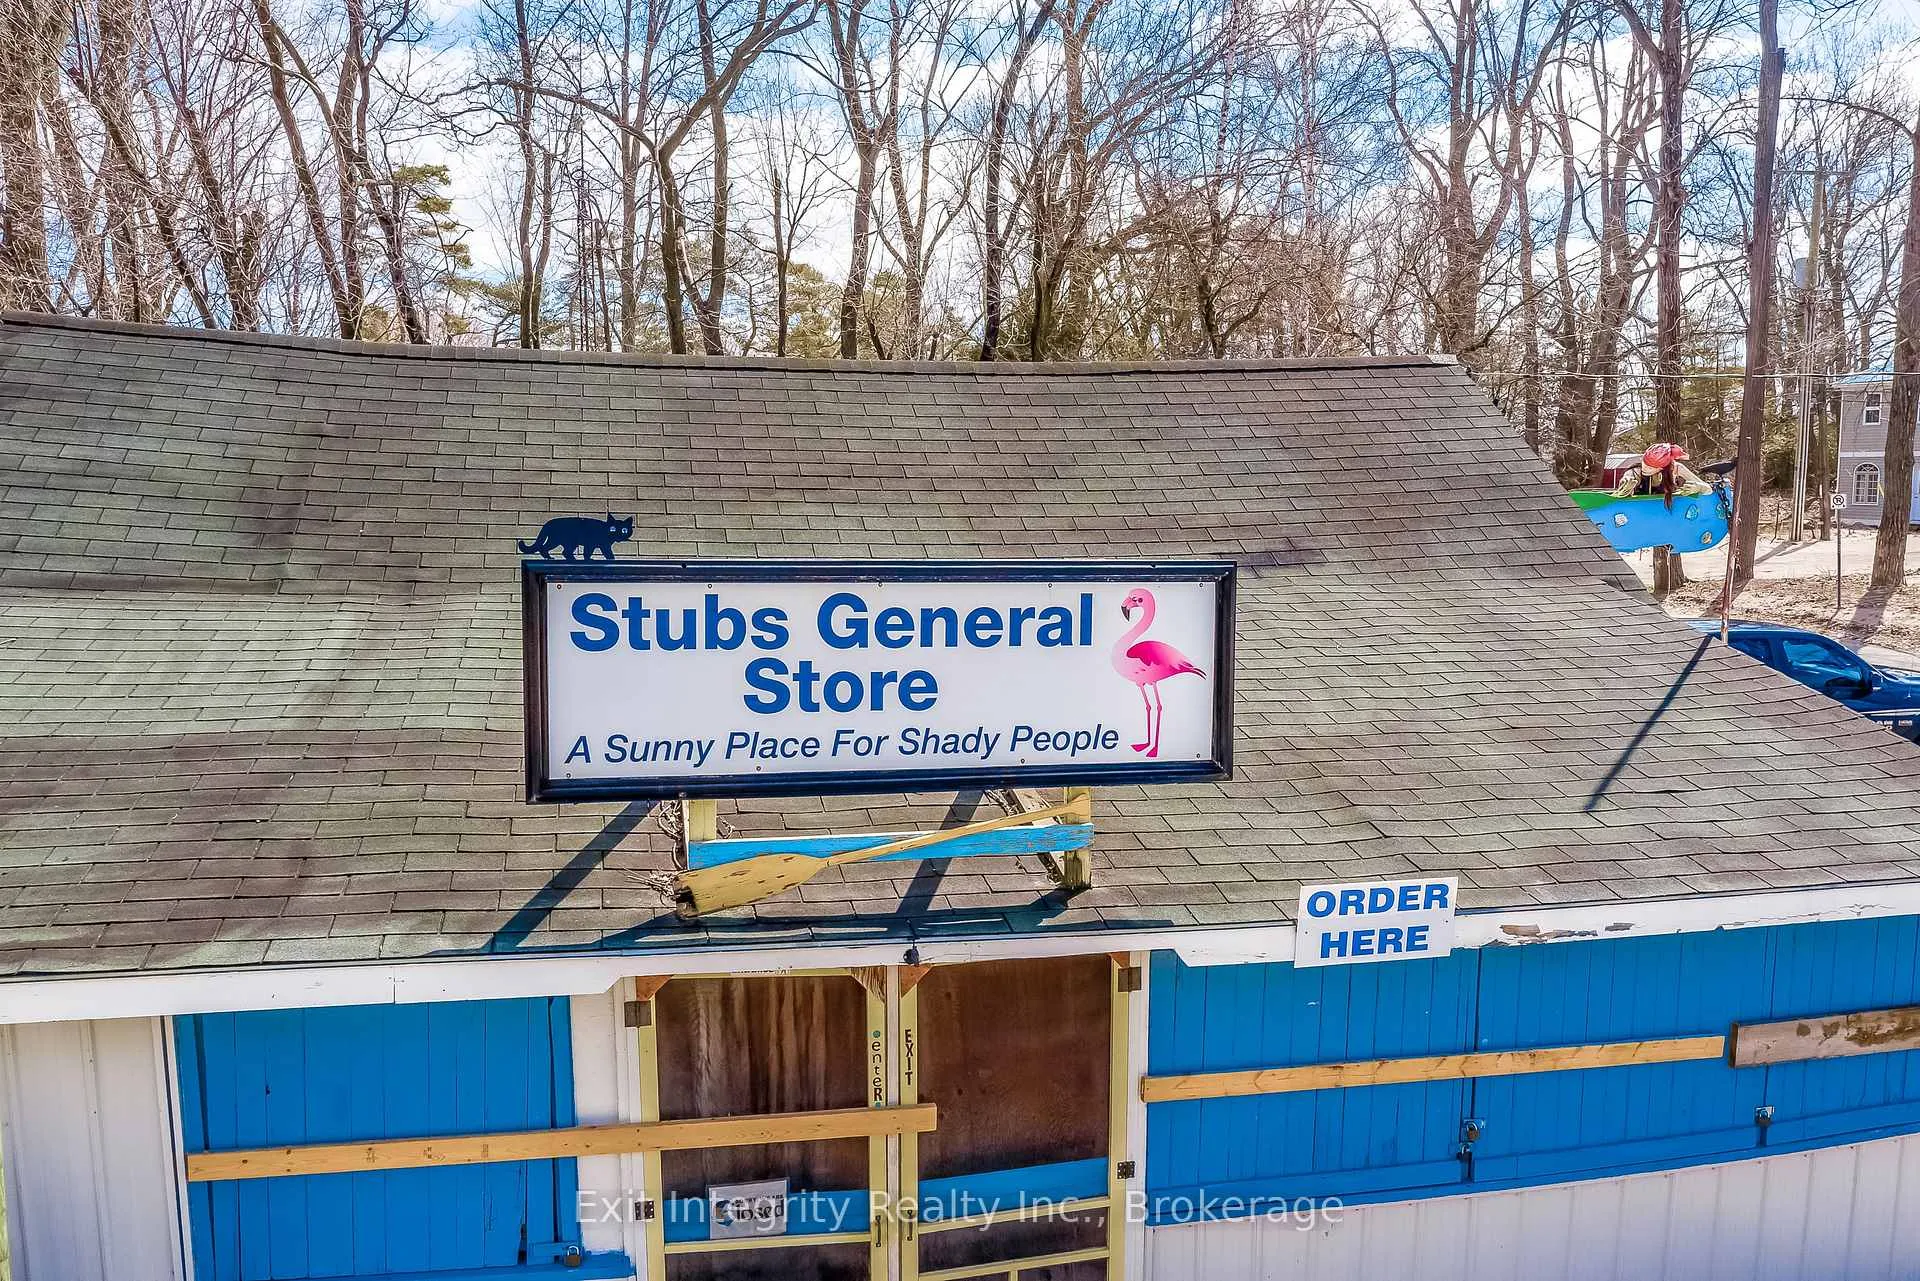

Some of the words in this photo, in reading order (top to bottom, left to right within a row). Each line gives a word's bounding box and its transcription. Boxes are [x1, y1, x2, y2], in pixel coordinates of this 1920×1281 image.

[570, 592, 790, 651] Stubs
[816, 592, 1093, 649] General
[743, 657, 939, 714] Store
[564, 736, 591, 764] A
[604, 734, 715, 768] Sunny
[725, 731, 820, 759] Place
[831, 729, 889, 756] For
[899, 726, 1001, 760] Shady
[1010, 724, 1119, 757] People
[1307, 883, 1449, 918] ORDER
[1320, 925, 1430, 959] HERE
[904, 1028, 914, 1086] EXIT
